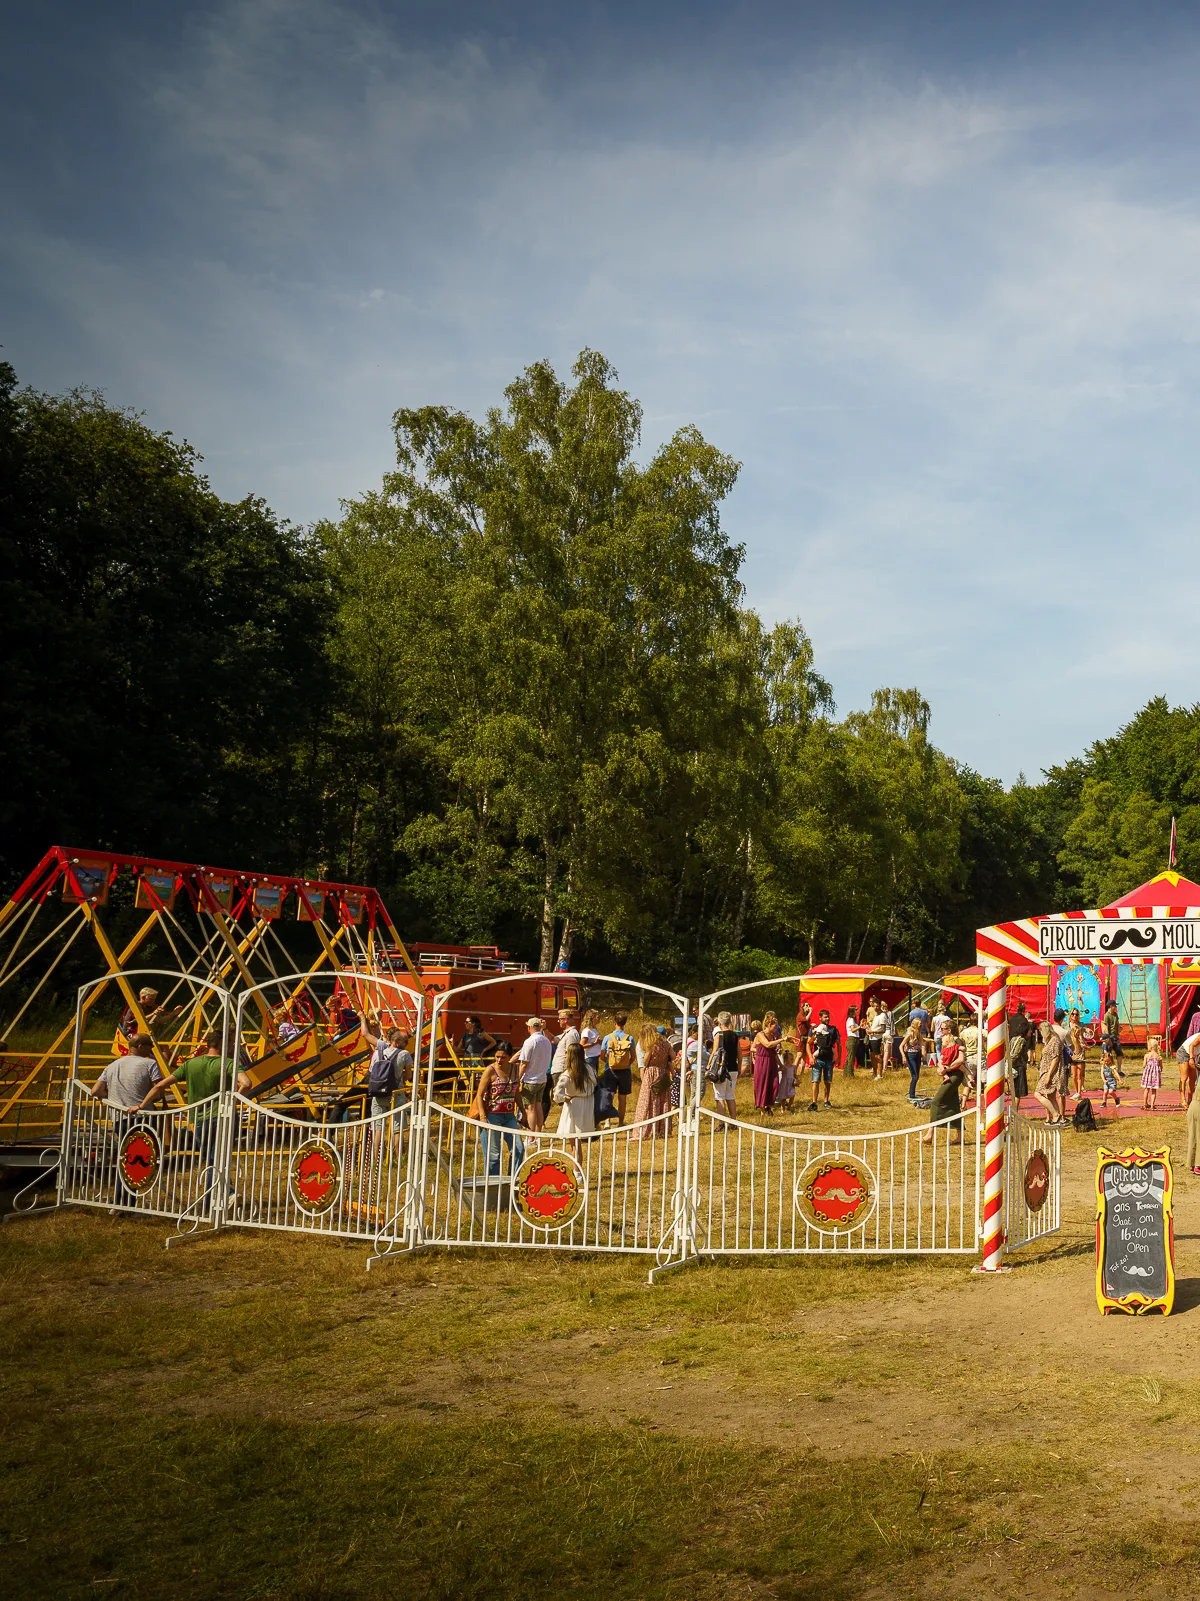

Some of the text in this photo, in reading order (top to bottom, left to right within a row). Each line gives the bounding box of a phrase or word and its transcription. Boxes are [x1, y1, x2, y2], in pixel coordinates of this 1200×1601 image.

[1040, 926, 1096, 956] CIRQUE
[1114, 1167, 1148, 1184] CIRCUS
[1114, 1203, 1130, 1212] ons
[1113, 1214, 1154, 1227] gaat om
[1121, 1228, 1148, 1241] 16:00
